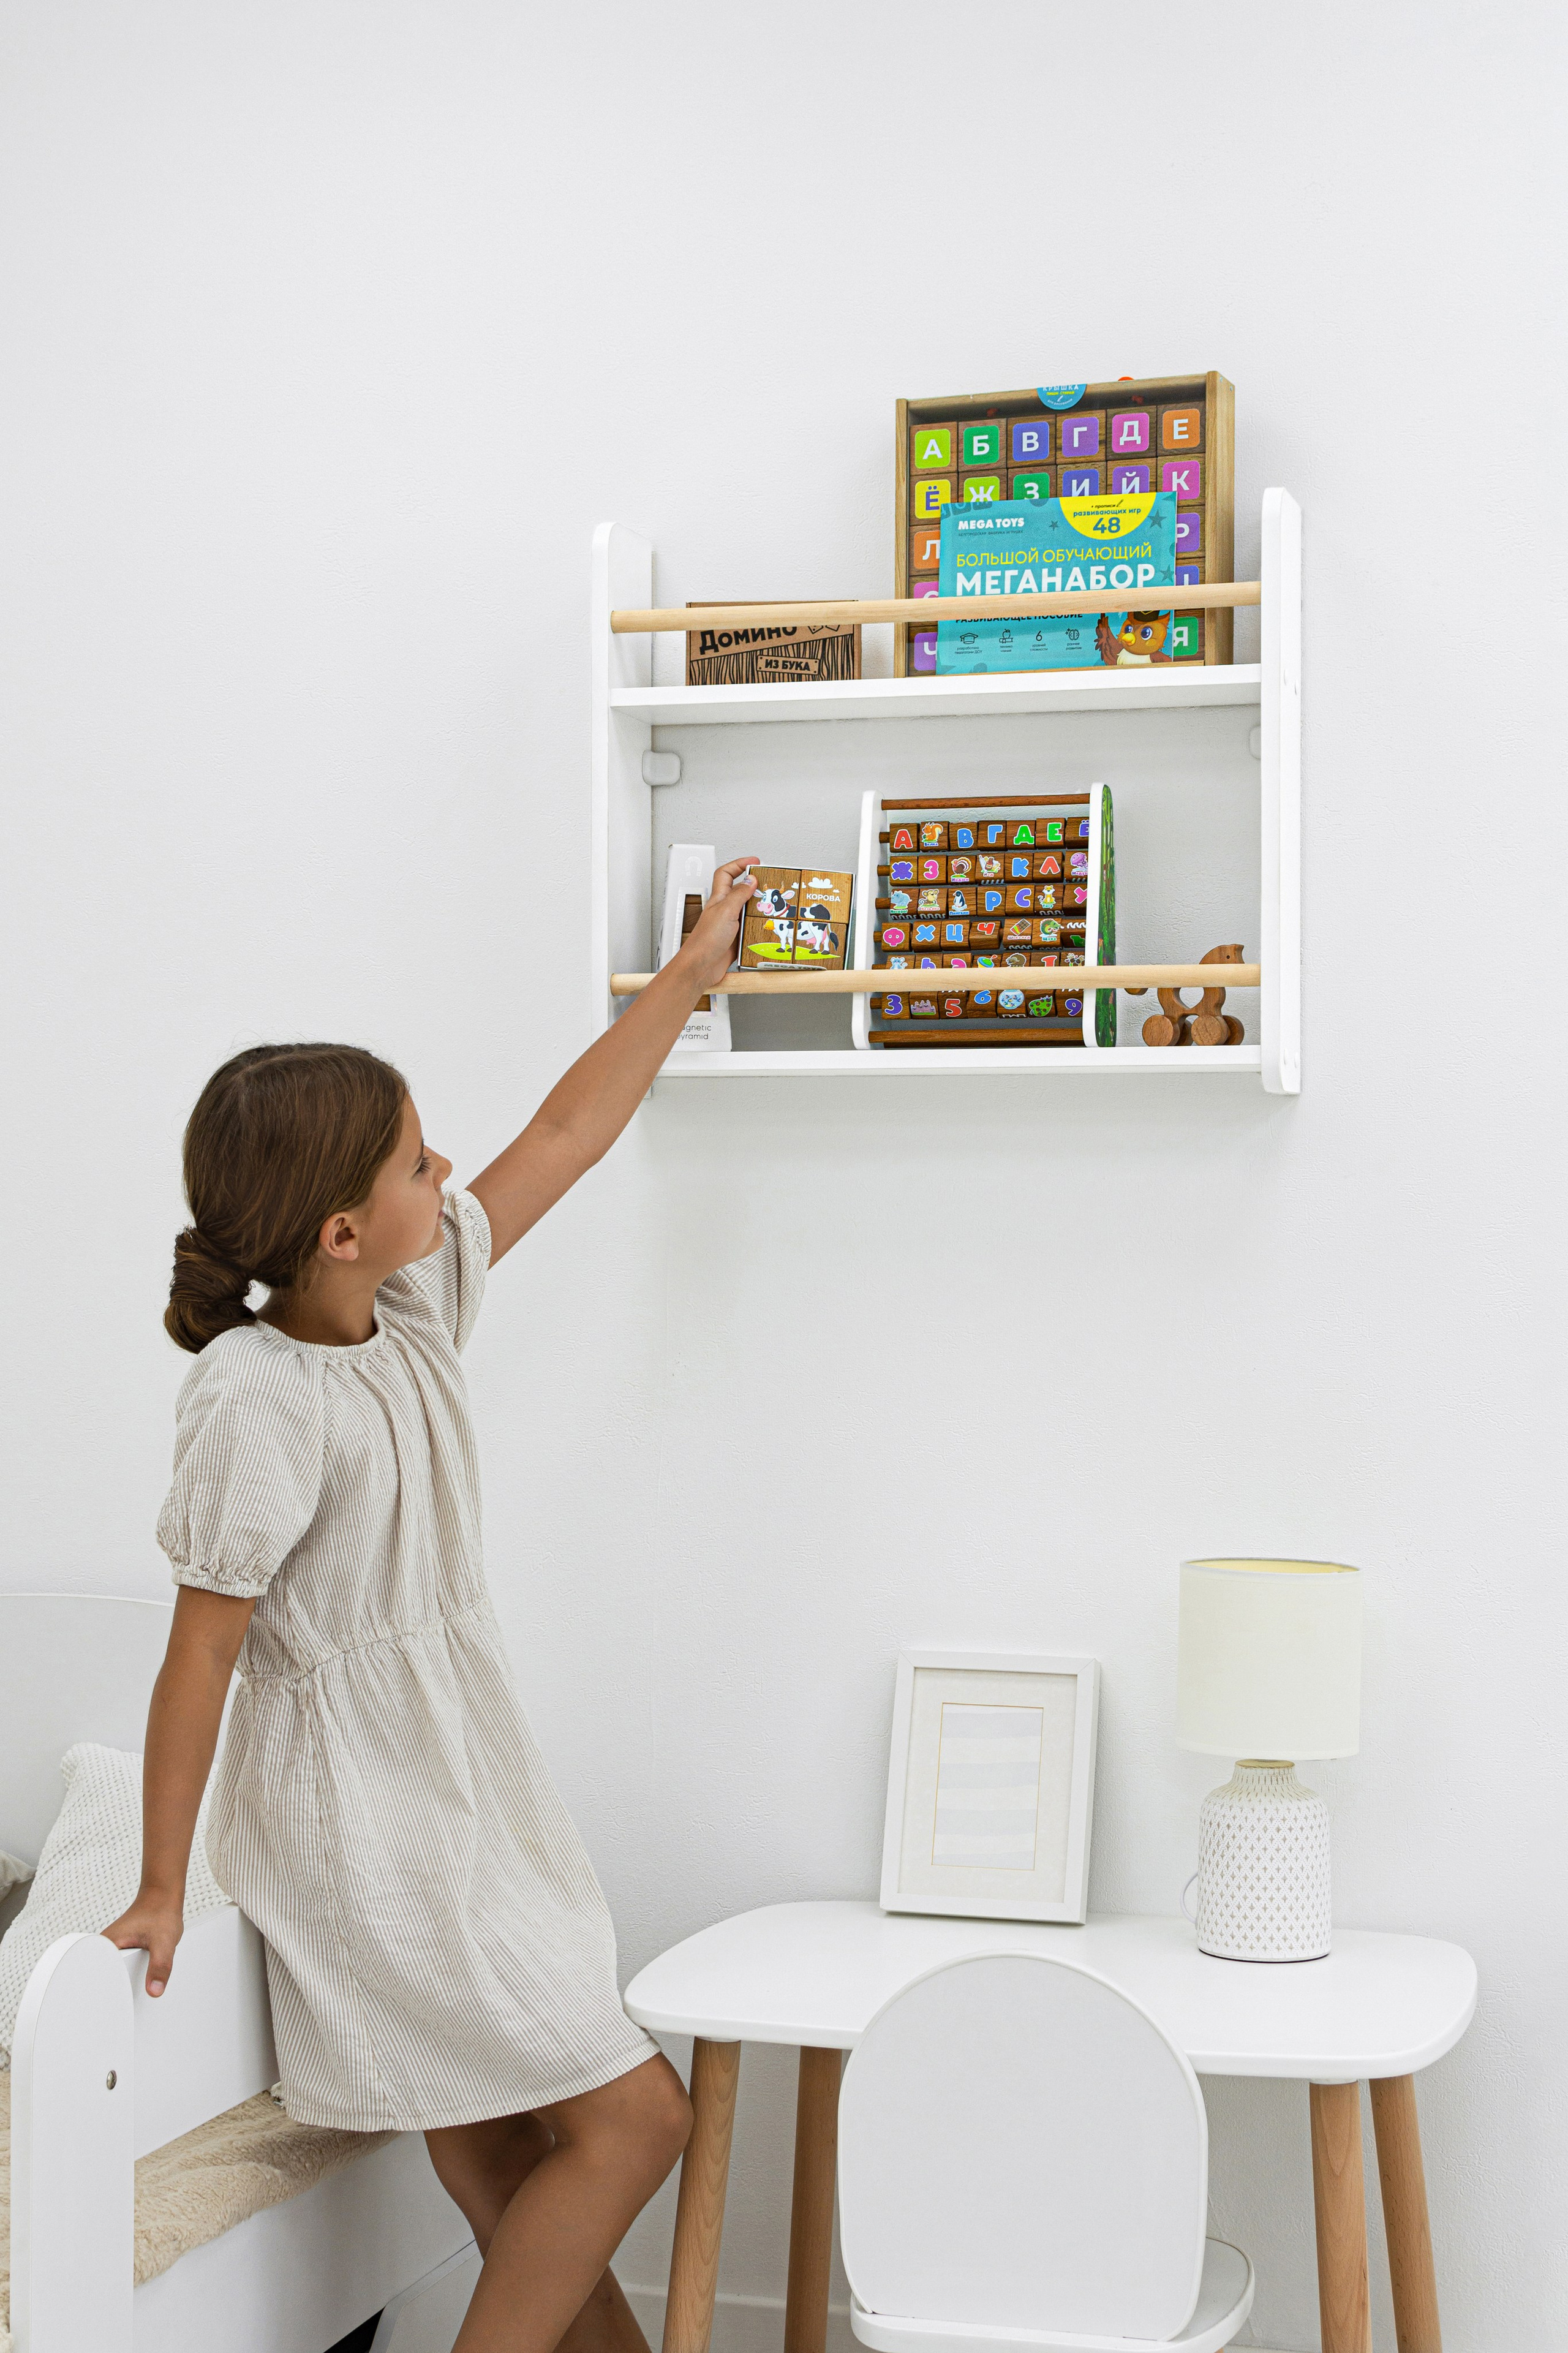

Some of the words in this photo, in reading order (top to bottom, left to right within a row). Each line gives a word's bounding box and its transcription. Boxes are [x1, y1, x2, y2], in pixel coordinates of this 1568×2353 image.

[922, 439, 943, 459] А
[973, 435, 990, 456] Б
[1022, 432, 1039, 452] В
[1073, 427, 1087, 447] Г
[1120, 420, 1141, 445] Д
[1173, 418, 1189, 440] Е
[925, 485, 940, 510] Ё
[969, 486, 995, 502] Ж
[1024, 483, 1039, 500] З
[1072, 478, 1090, 497] И
[1121, 472, 1140, 494] Й
[1172, 470, 1189, 491] К
[958, 519, 994, 530] MEGA
[995, 518, 1025, 528] TOYS
[1073, 509, 1126, 518] развивающих
[1093, 517, 1120, 534] 48
[957, 547, 1039, 567] БОЛЬШОЙ
[1042, 542, 1152, 563] ОБУЧАЮЩИЙ
[956, 564, 1155, 597] МЕГАНАБОР
[1036, 630, 1042, 641] 6
[1174, 626, 1188, 647] Я
[765, 660, 779, 669] ИЗ
[782, 660, 810, 671] БУКА
[894, 829, 913, 848] А
[957, 828, 974, 848] В
[988, 825, 1003, 844] Г
[1014, 825, 1035, 845] Д
[1047, 822, 1062, 842] Е
[891, 861, 913, 880] Ж
[1012, 858, 1029, 877] К
[1039, 856, 1060, 874] Л
[806, 893, 841, 902] КОРОВА
[986, 891, 1001, 912] Р
[1015, 888, 1031, 907] С
[883, 927, 904, 946] Ф
[915, 924, 936, 942] Х
[946, 924, 963, 942] Ц
[945, 999, 962, 1016] 5
[974, 990, 992, 1004] 6
[1066, 999, 1082, 1015] 9
